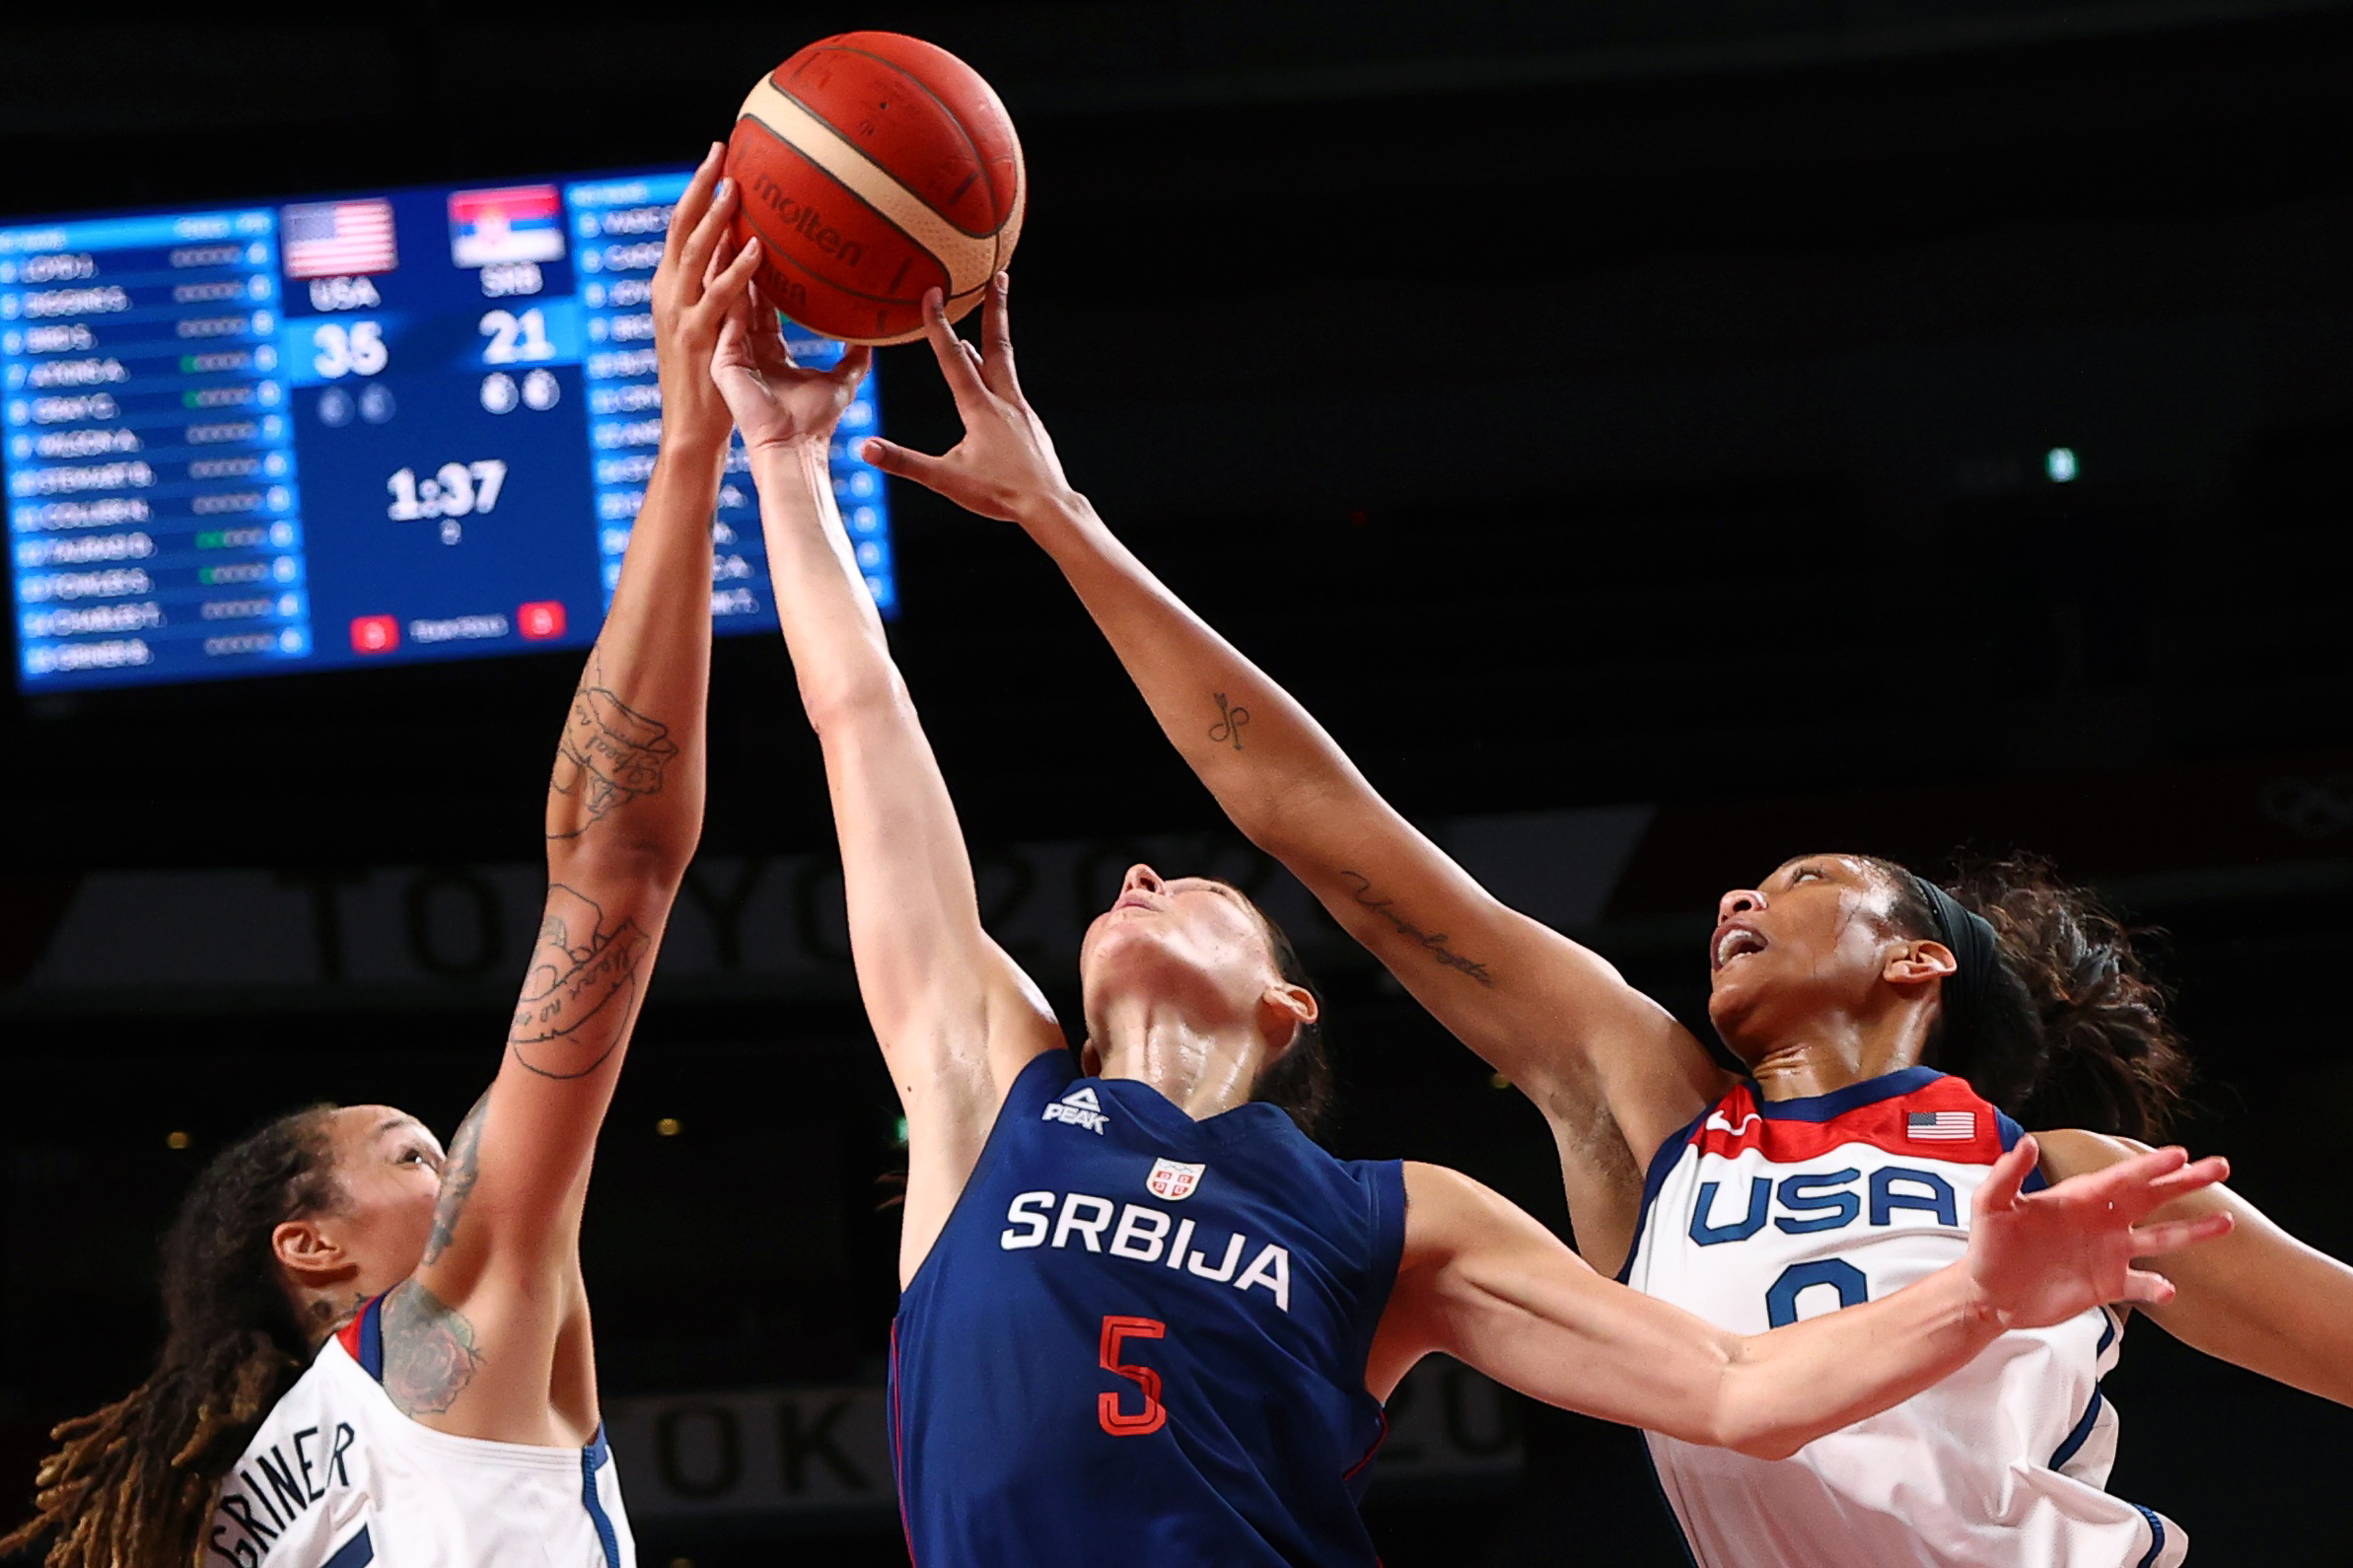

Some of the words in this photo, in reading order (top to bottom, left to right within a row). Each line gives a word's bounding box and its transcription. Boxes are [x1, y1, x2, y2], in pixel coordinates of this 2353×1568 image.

[753, 175, 866, 267] molten
[479, 308, 556, 363] 21
[387, 460, 508, 520] 1:37
[274, 852, 850, 982] TOY
[1042, 1103, 1109, 1135] PEAK
[1000, 1190, 1292, 1314] SRBIJA
[1688, 1166, 1959, 1247] USA
[1098, 1316, 1167, 1436] 5
[210, 1421, 355, 1568] GRINER
